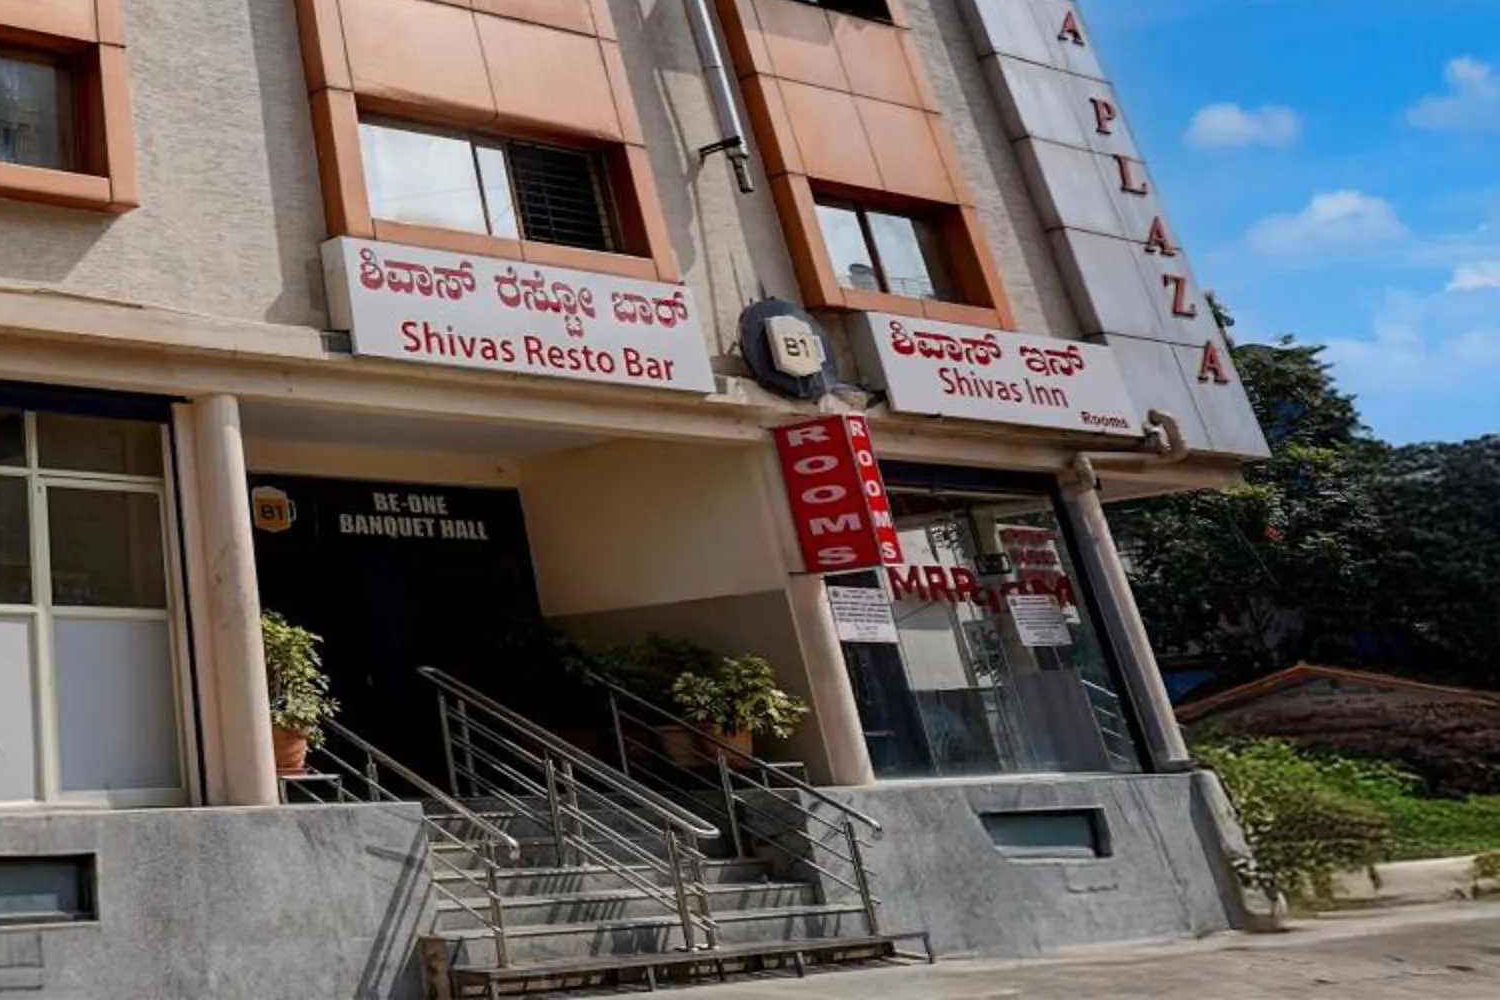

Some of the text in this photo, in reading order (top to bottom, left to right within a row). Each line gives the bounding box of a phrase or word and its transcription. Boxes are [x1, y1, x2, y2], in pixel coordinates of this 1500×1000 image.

[1088, 98, 1228, 384] PLAZA
[401, 321, 674, 381] Shivas Resto Bar
[783, 336, 812, 358] B1
[938, 367, 1069, 409] Shivas Inn
[1080, 410, 1130, 430] Rooms
[373, 491, 449, 516] BE-ONE
[786, 425, 863, 566] ROOMS
[849, 418, 897, 560] ROOMS
[260, 504, 284, 521] B1
[339, 513, 489, 540] BANQUET HALL
